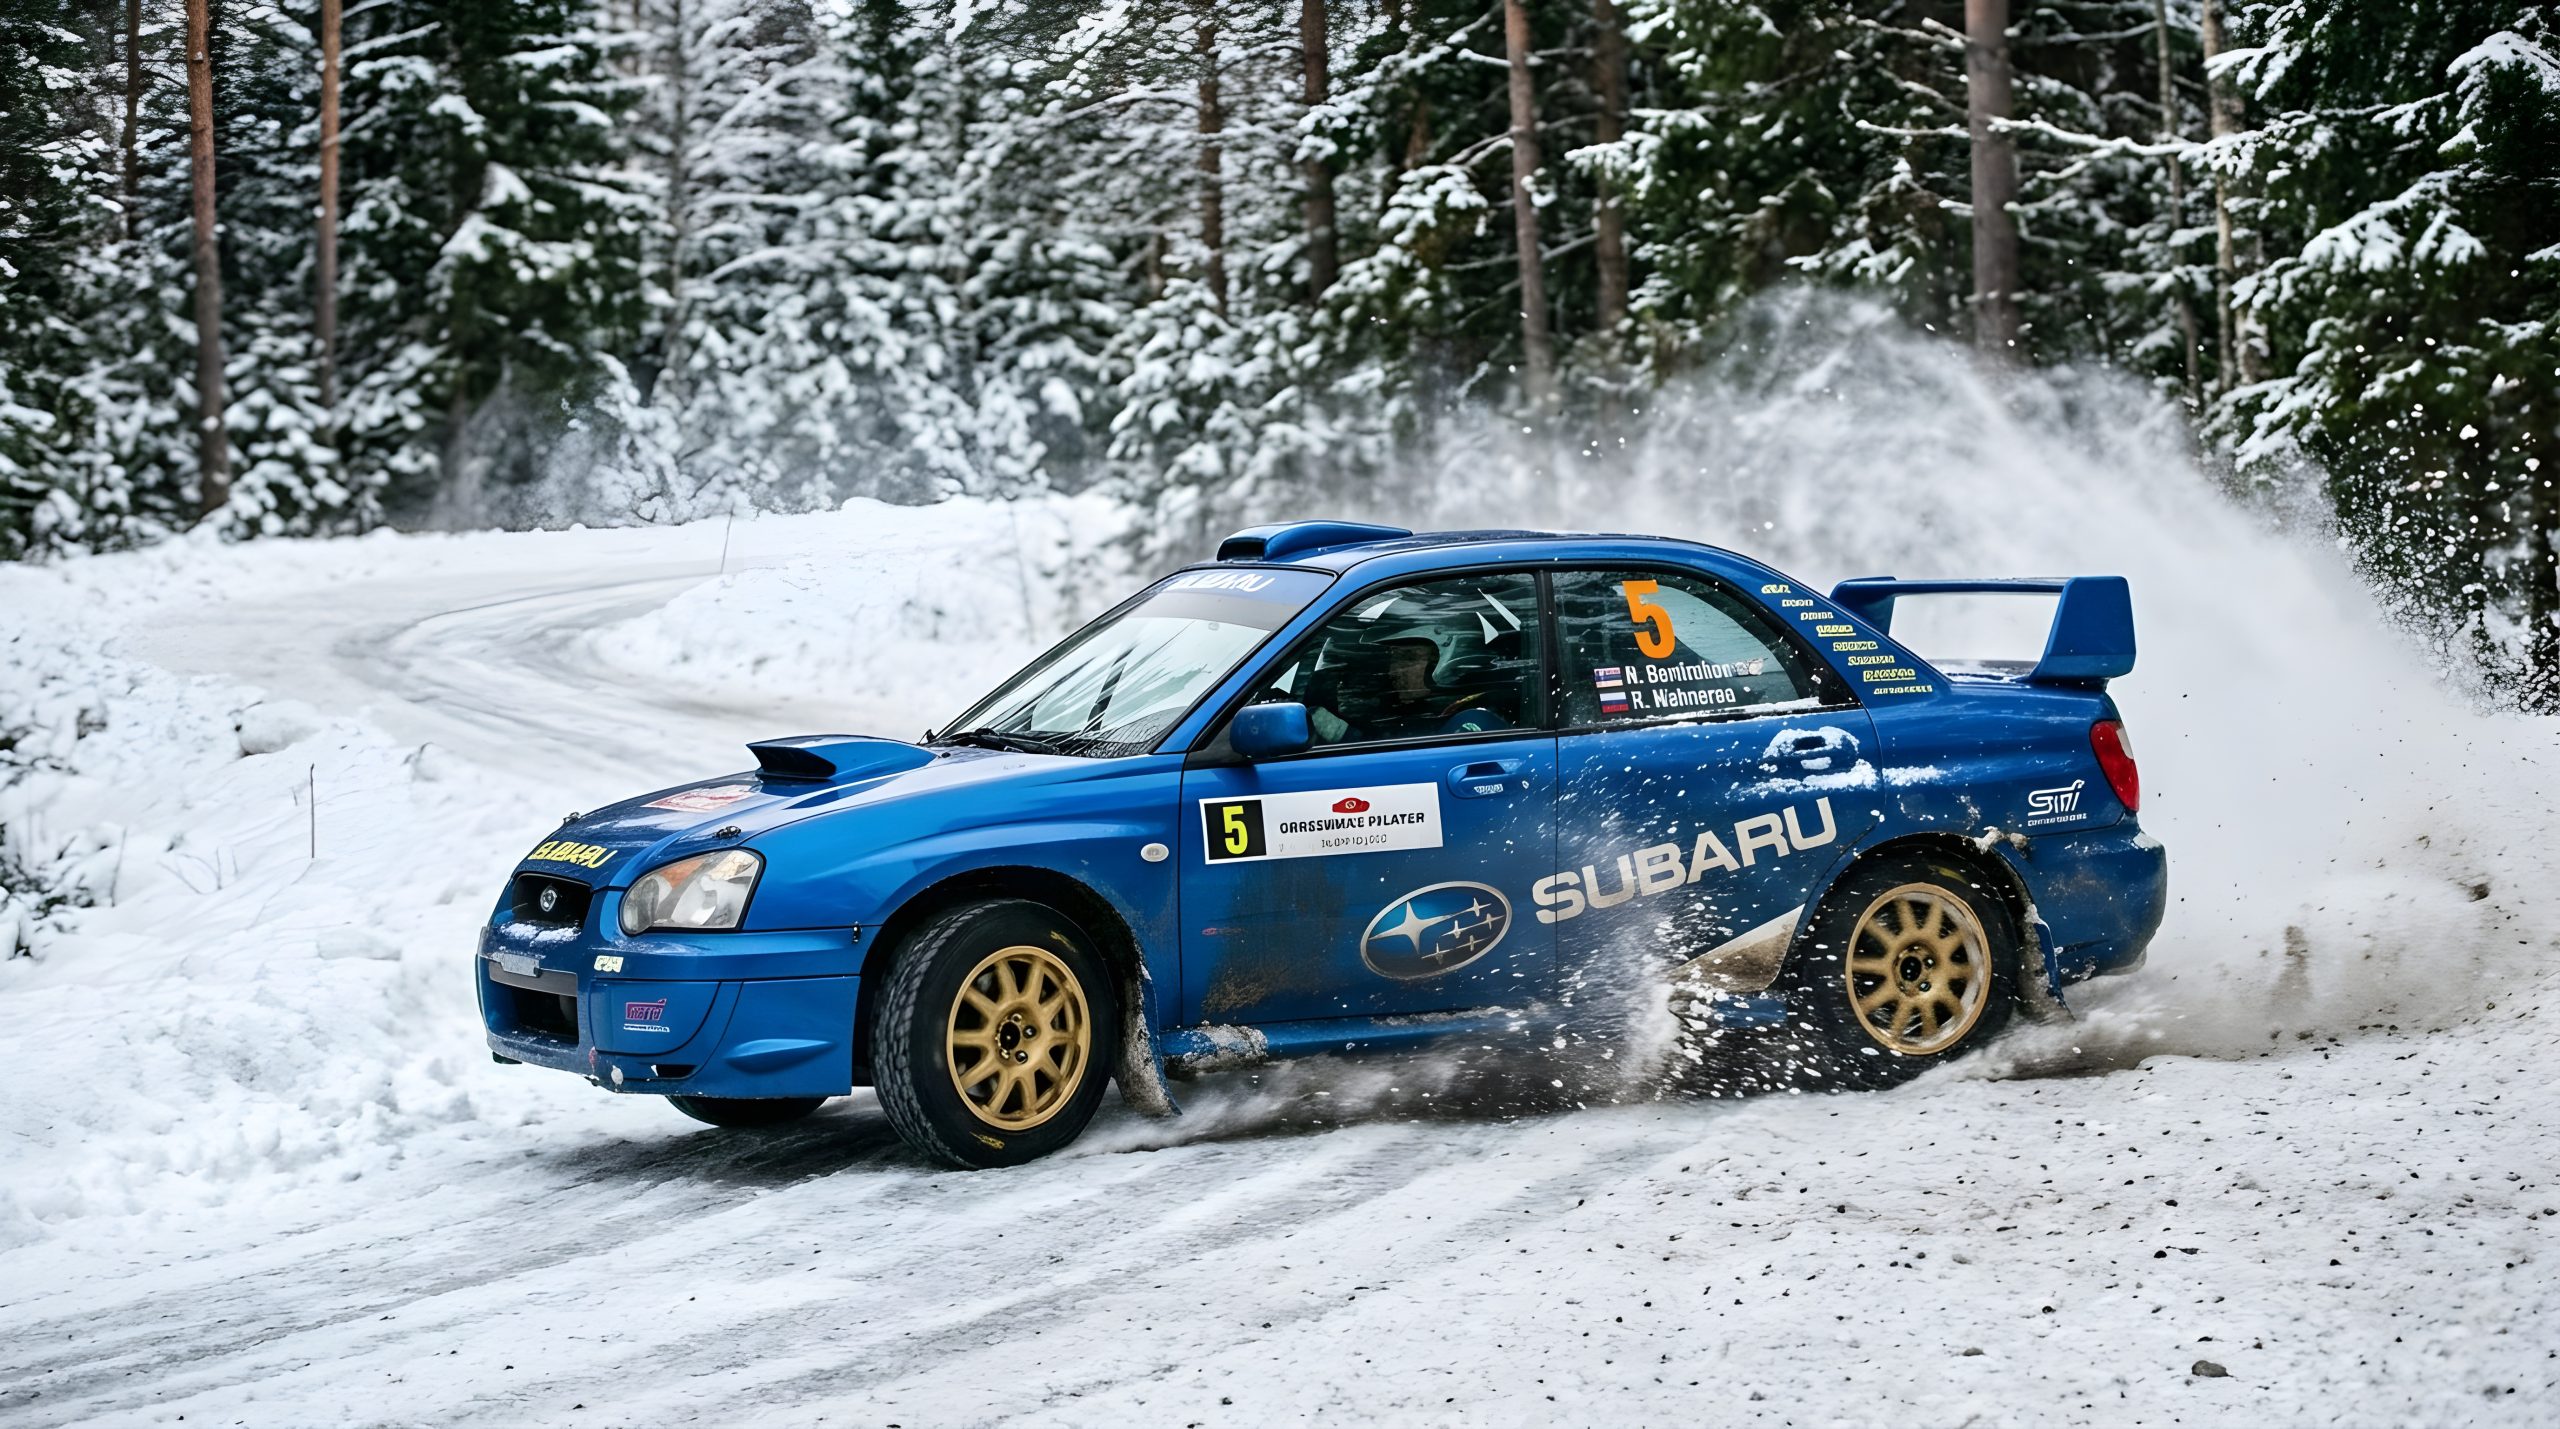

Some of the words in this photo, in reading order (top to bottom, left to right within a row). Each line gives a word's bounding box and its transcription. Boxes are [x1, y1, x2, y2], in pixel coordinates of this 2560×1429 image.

[1622, 580, 1675, 659] 5
[1625, 665, 1644, 684] N.
[1631, 691, 1650, 709] R.
[1222, 806, 1248, 855] 5
[1532, 797, 1837, 924] SUBARU
